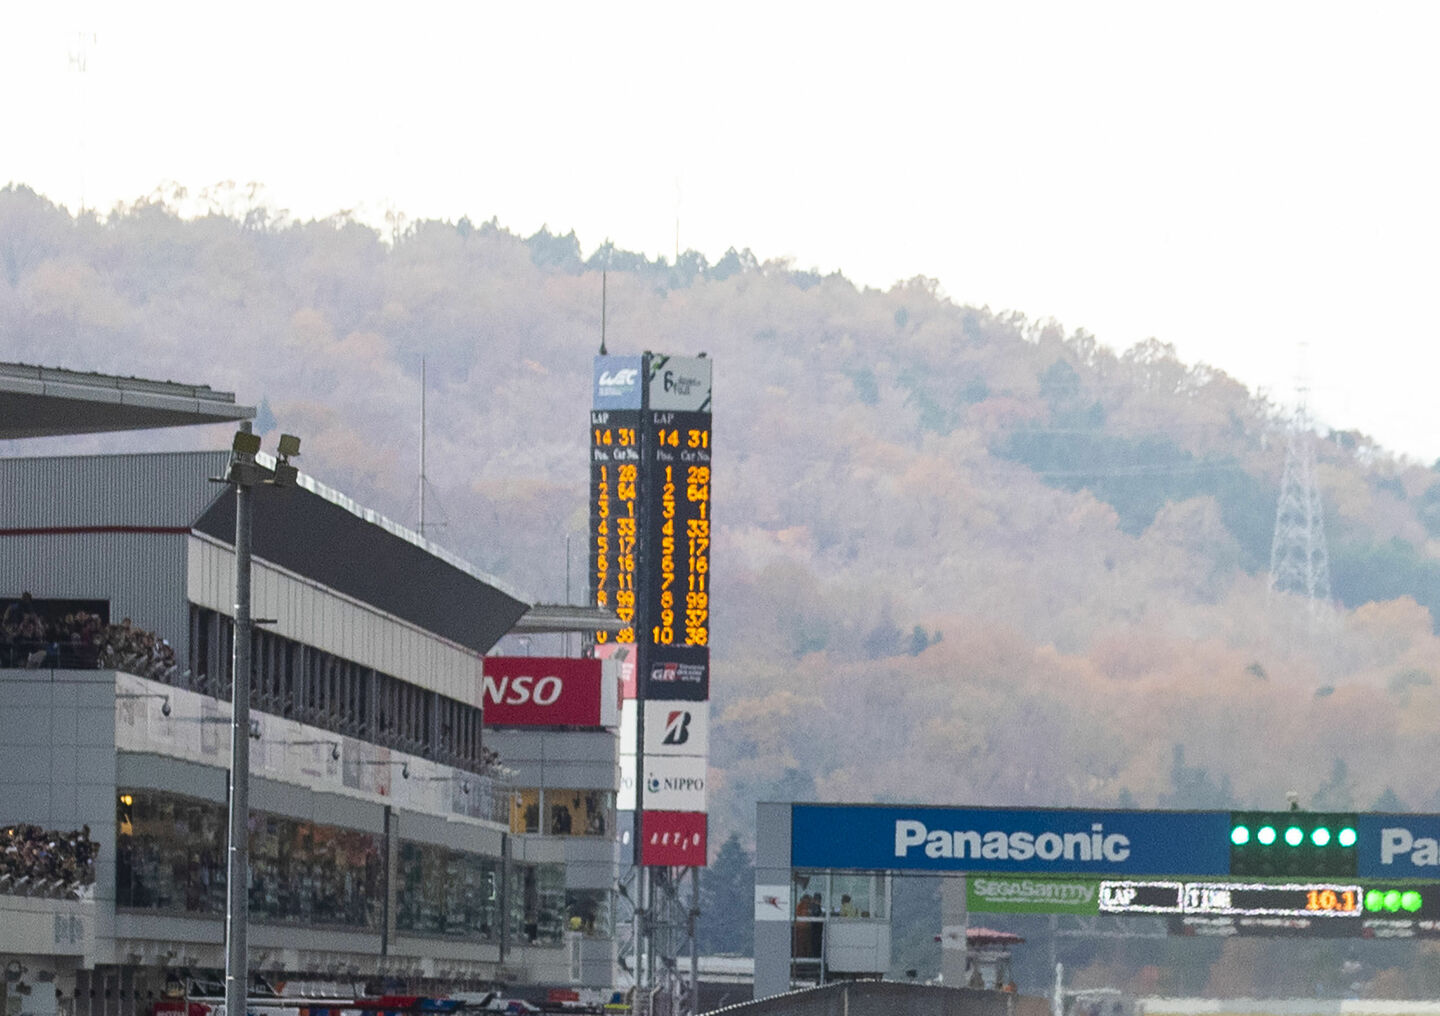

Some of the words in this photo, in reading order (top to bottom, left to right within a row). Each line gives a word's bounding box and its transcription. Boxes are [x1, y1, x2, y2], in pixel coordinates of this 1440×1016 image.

[591, 412, 609, 424] LAP
[653, 412, 675, 424] LAP
[595, 428, 612, 446] 14
[618, 428, 636, 446] 31
[658, 428, 679, 448] 14
[687, 429, 709, 448] 31
[601, 465, 607, 482] 1
[665, 465, 672, 482] 1
[687, 466, 710, 484] 28
[662, 482, 675, 501] 2
[687, 484, 709, 502] 64
[598, 500, 609, 518] 3
[627, 501, 634, 517] 1
[662, 501, 675, 518] 3
[699, 501, 706, 519] 1
[598, 519, 609, 535] 4
[617, 518, 636, 536] 33
[661, 519, 674, 536] 4
[687, 519, 709, 538] 33
[597, 536, 608, 554] 5
[618, 536, 636, 554] 17
[662, 536, 674, 555] 5
[688, 538, 709, 556] 17
[597, 554, 608, 571] 6
[617, 554, 635, 572] 16
[661, 554, 674, 572] 6
[688, 556, 709, 574] 16
[597, 572, 607, 590] 7
[617, 572, 632, 590] 11
[661, 573, 675, 590] 7
[688, 573, 706, 591] 11
[661, 609, 674, 626] 9
[685, 609, 708, 628] 37
[653, 625, 674, 644] 10
[685, 627, 708, 646] 38
[663, 777, 704, 791] NIPPO
[894, 818, 1131, 862] Panasonic
[1102, 888, 1136, 906] LAP
[1306, 889, 1356, 912] 10.1
